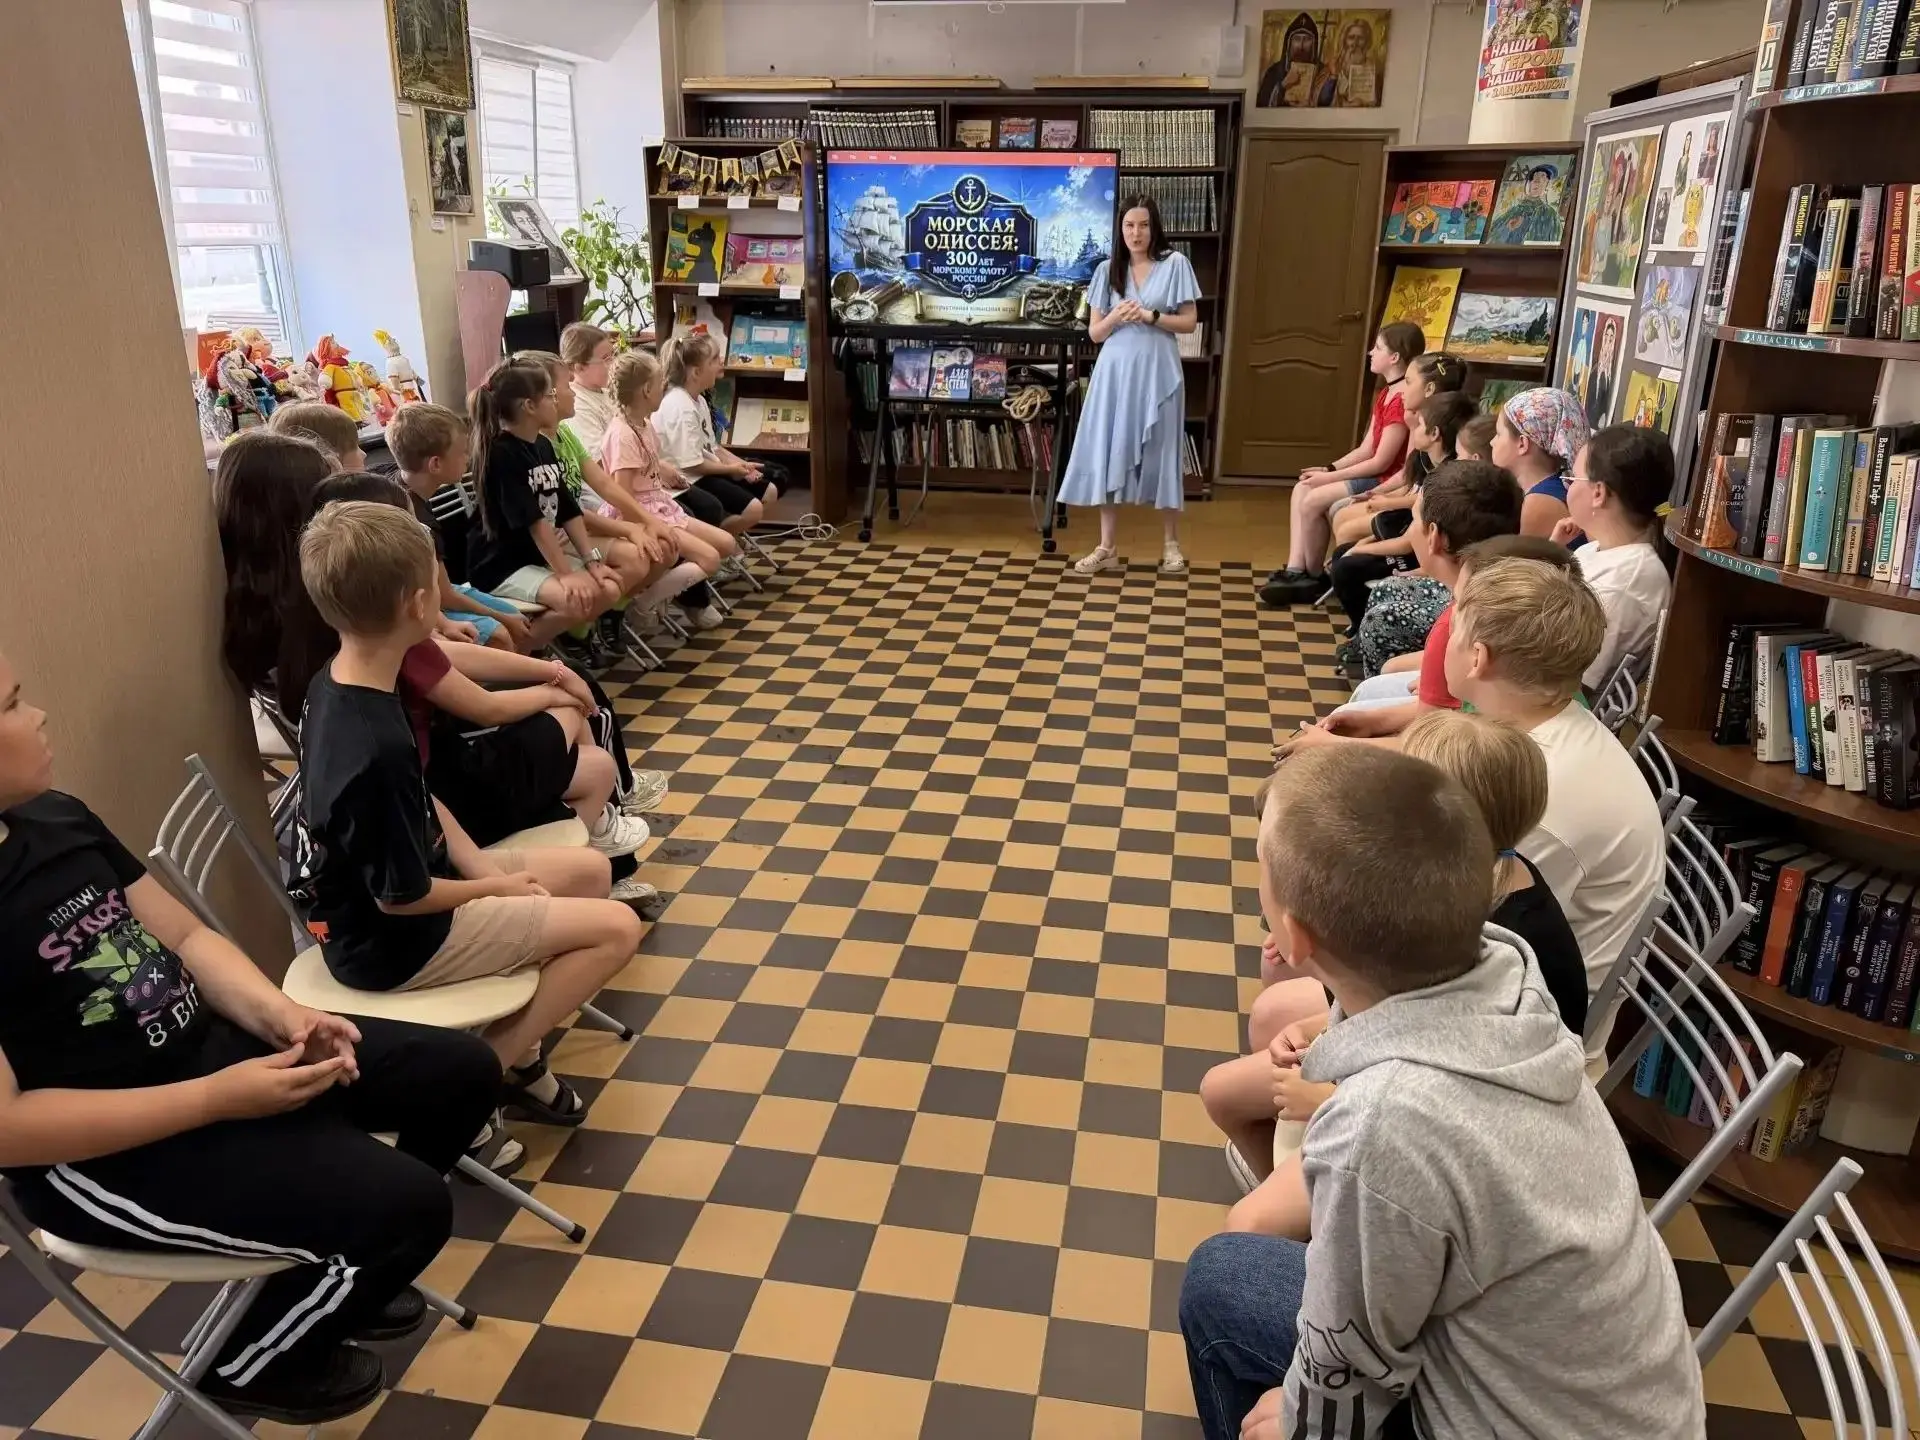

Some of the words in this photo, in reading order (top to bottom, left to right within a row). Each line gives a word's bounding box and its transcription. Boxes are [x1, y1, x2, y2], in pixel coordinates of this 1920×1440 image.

[1491, 38, 1538, 58] НАШИ
[1808, 26, 1823, 67] ОЛЕГ
[1825, 16, 1848, 73] Переселенцы
[1502, 48, 1565, 70] ГЕРОИ!
[1487, 70, 1526, 87] НАШИ
[1893, 191, 1905, 230] ШТРАФНОЕ
[927, 216, 1016, 234] МОРСКАЯ
[924, 234, 1019, 251] ОДИССЕЯ:
[1888, 233, 1900, 274] ПРОКЛЯТИЕ
[945, 251, 978, 266] 300
[978, 257, 995, 266] ЛЕТ
[932, 265, 978, 275] МОРСКОМУ
[979, 265, 1008, 276] ФЛОТУ
[952, 275, 987, 283] РОССИИ
[1743, 331, 1814, 347] ФАНТАСТИКА
[1873, 437, 1888, 482] Валентин
[1869, 483, 1881, 506] Гафт
[1705, 550, 1761, 576] НАУЧПОП
[1864, 735, 1874, 759] ЗВЕЗДА
[49, 884, 102, 928] BRAWL
